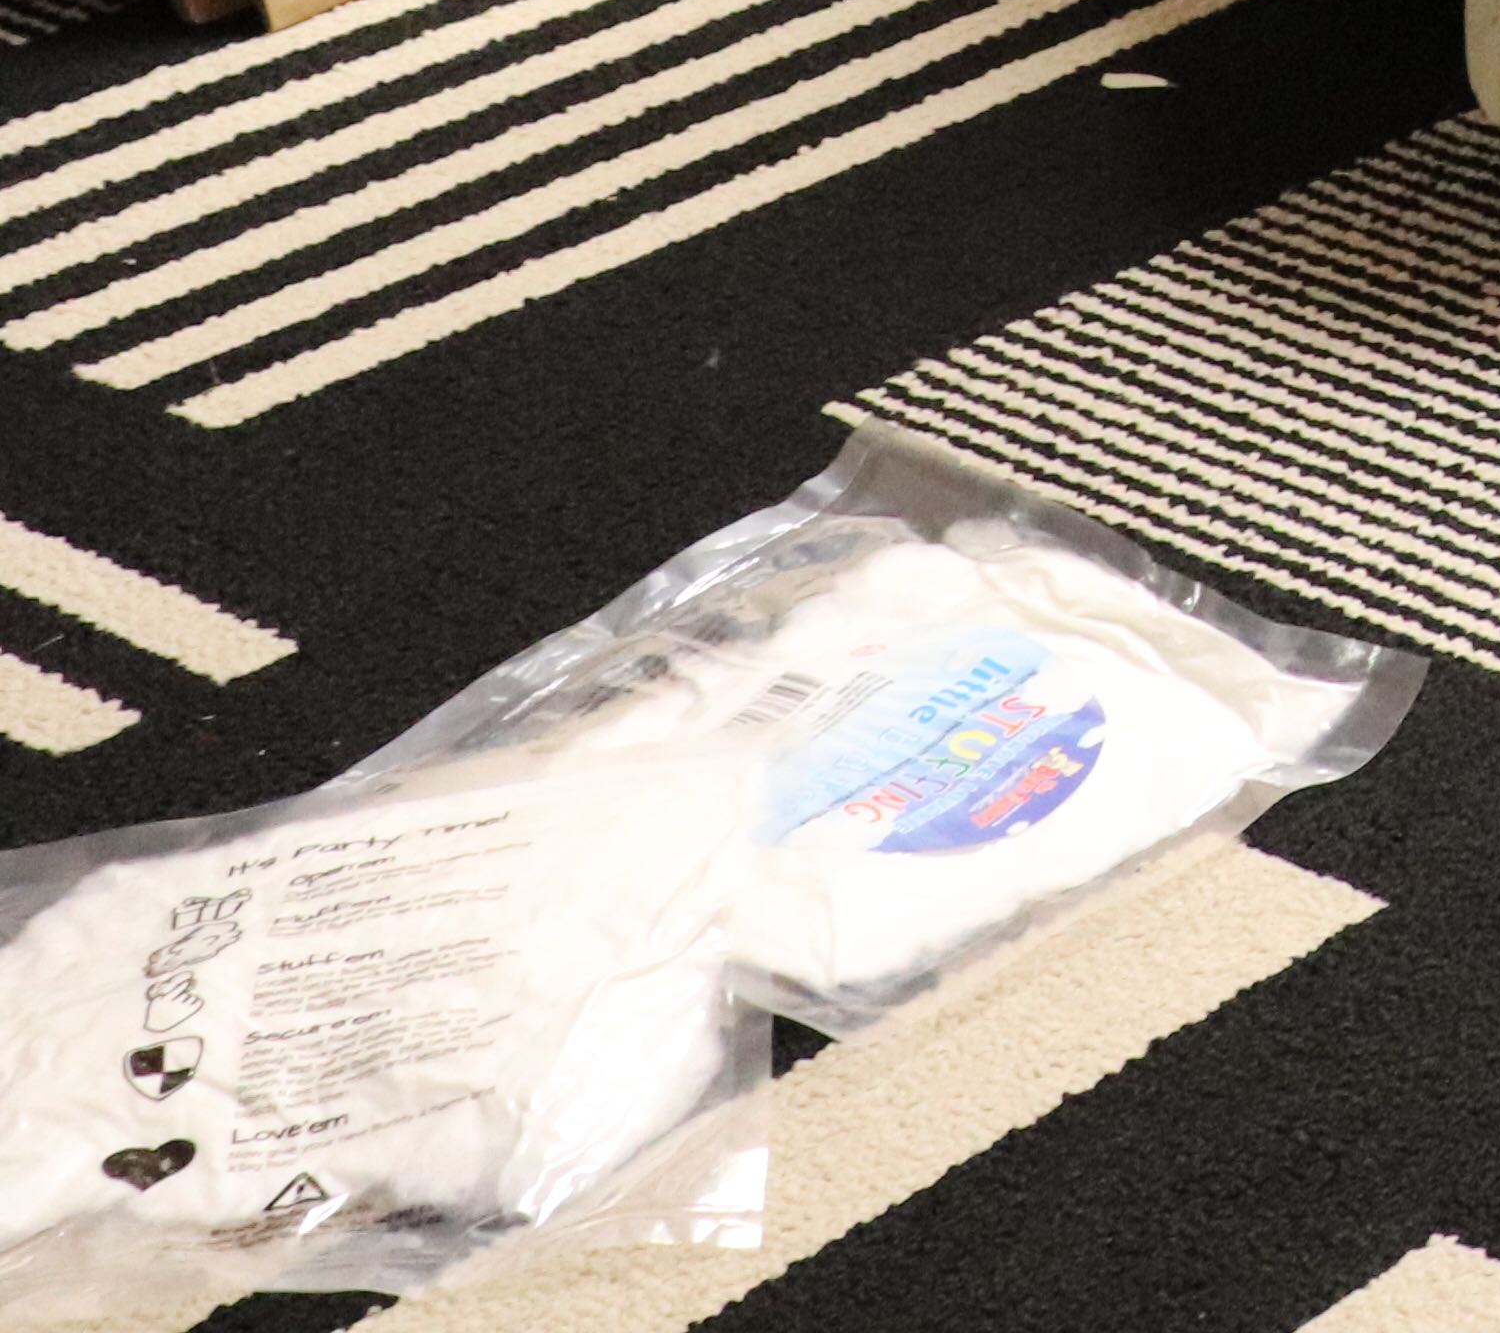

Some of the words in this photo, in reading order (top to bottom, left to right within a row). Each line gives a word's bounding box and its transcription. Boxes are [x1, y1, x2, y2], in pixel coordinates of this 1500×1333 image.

[909, 656, 1012, 724] little
[844, 694, 1047, 824] STUFFING
[293, 834, 405, 859] Party
[231, 1114, 349, 1144] Love'em
